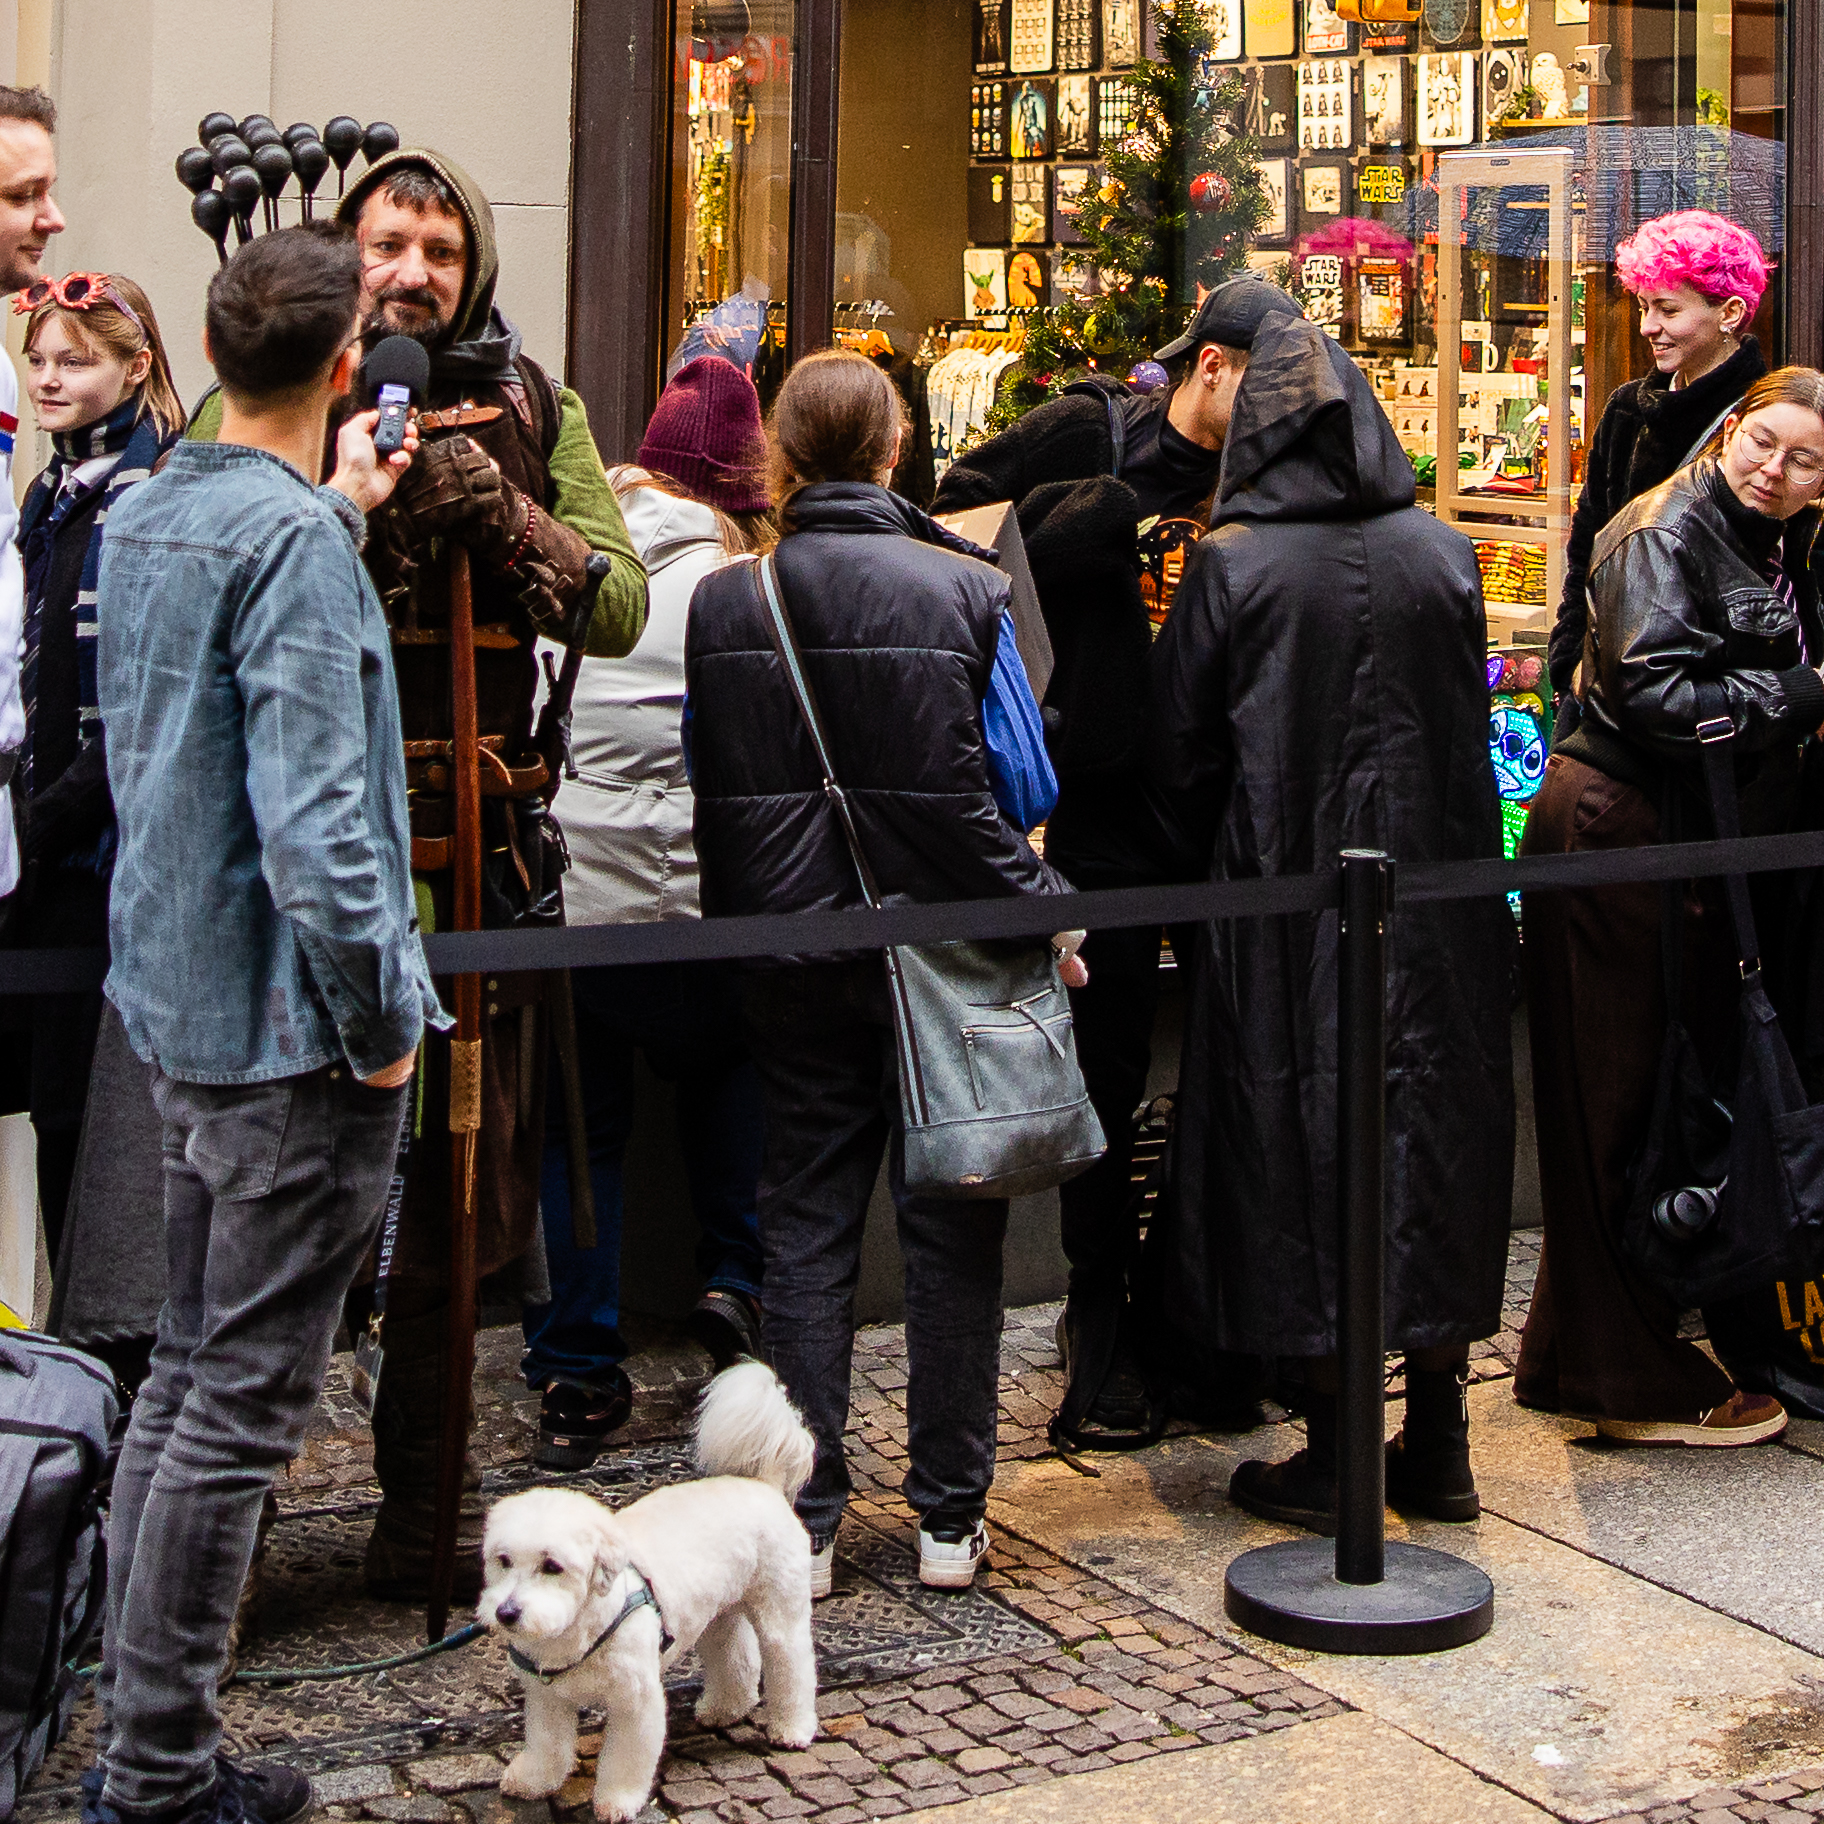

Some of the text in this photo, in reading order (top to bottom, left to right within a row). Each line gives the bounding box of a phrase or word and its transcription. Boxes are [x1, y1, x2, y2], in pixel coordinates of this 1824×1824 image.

[1361, 165, 1404, 183] STAR
[1361, 182, 1405, 203] WARS
[1303, 255, 1339, 272] STAR
[1303, 272, 1341, 289] WARS
